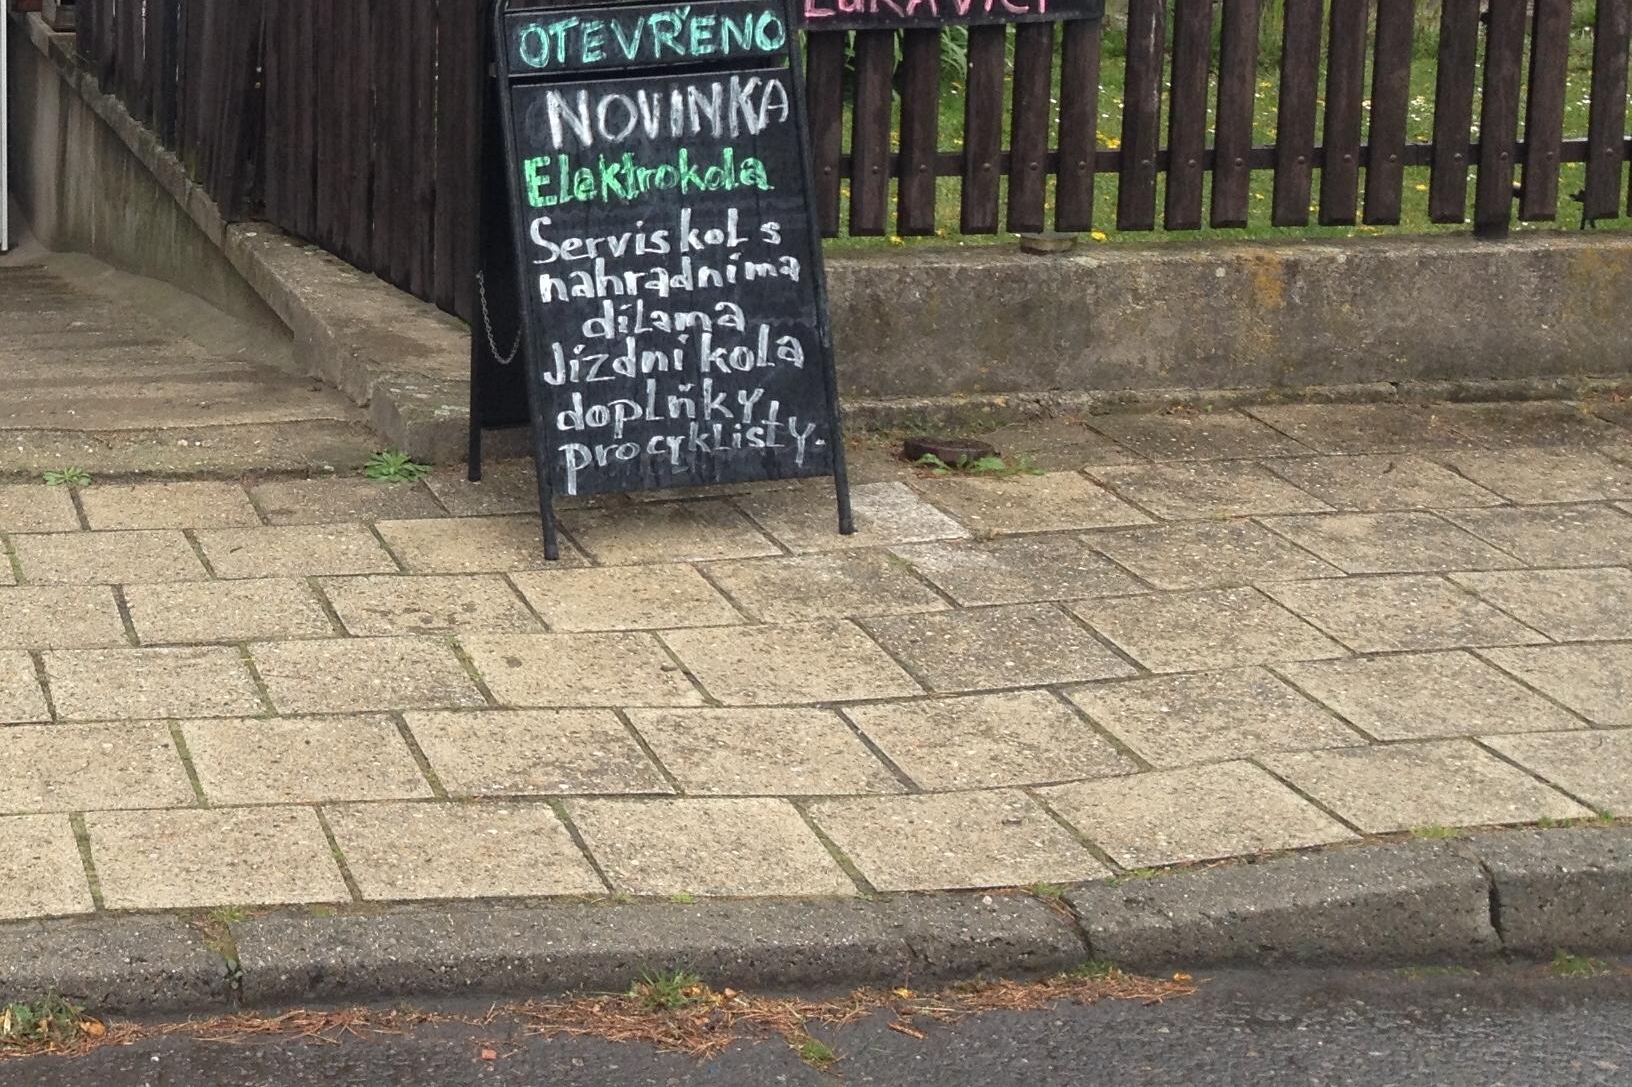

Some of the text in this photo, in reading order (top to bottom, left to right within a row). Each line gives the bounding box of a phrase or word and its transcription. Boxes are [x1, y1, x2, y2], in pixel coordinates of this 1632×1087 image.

[519, 5, 786, 68] OTEVŘENO
[545, 75, 789, 149] NOVINKA
[524, 147, 775, 208] Elektrokola
[530, 216, 671, 264] Servis
[760, 221, 781, 245] s
[701, 324, 804, 373] kola
[557, 378, 765, 439] doplňky
